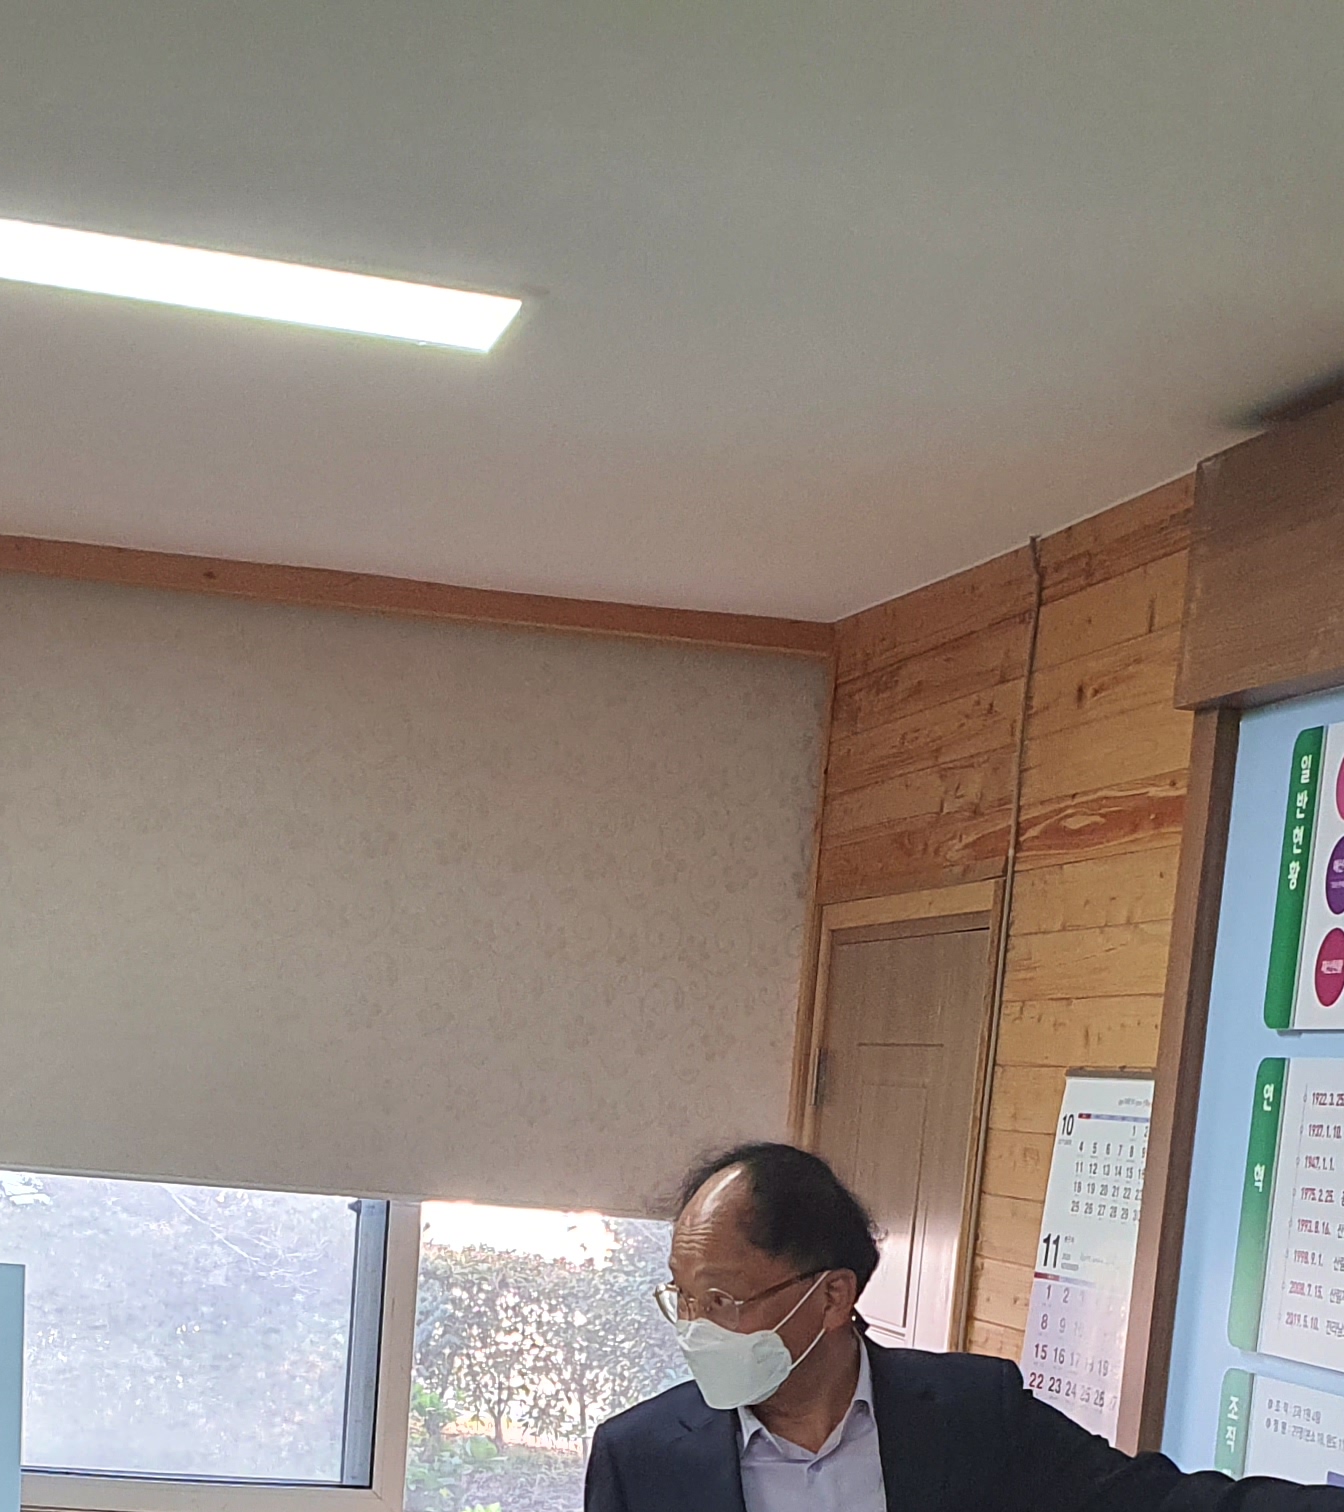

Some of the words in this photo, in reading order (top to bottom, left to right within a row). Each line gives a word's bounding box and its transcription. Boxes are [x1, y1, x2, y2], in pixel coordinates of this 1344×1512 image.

[1062, 1114, 1074, 1135] 10
[1079, 1141, 1084, 1152] 4
[1076, 1162, 1083, 1173] 11
[1089, 1163, 1097, 1174] 12
[1103, 1164, 1110, 1176] 13
[1115, 1166, 1122, 1176] 14
[1123, 1187, 1131, 1199] 22
[1043, 1233, 1060, 1268] 11
[1047, 1285, 1051, 1300] 1
[1063, 1288, 1069, 1303] 2
[1041, 1314, 1048, 1329] 8
[1060, 1317, 1066, 1333] 9
[1034, 1344, 1048, 1360] 15
[1053, 1347, 1064, 1364] 16
[1029, 1372, 1044, 1389] 22
[1048, 1376, 1061, 1394] 23
[1065, 1381, 1076, 1398] 24
